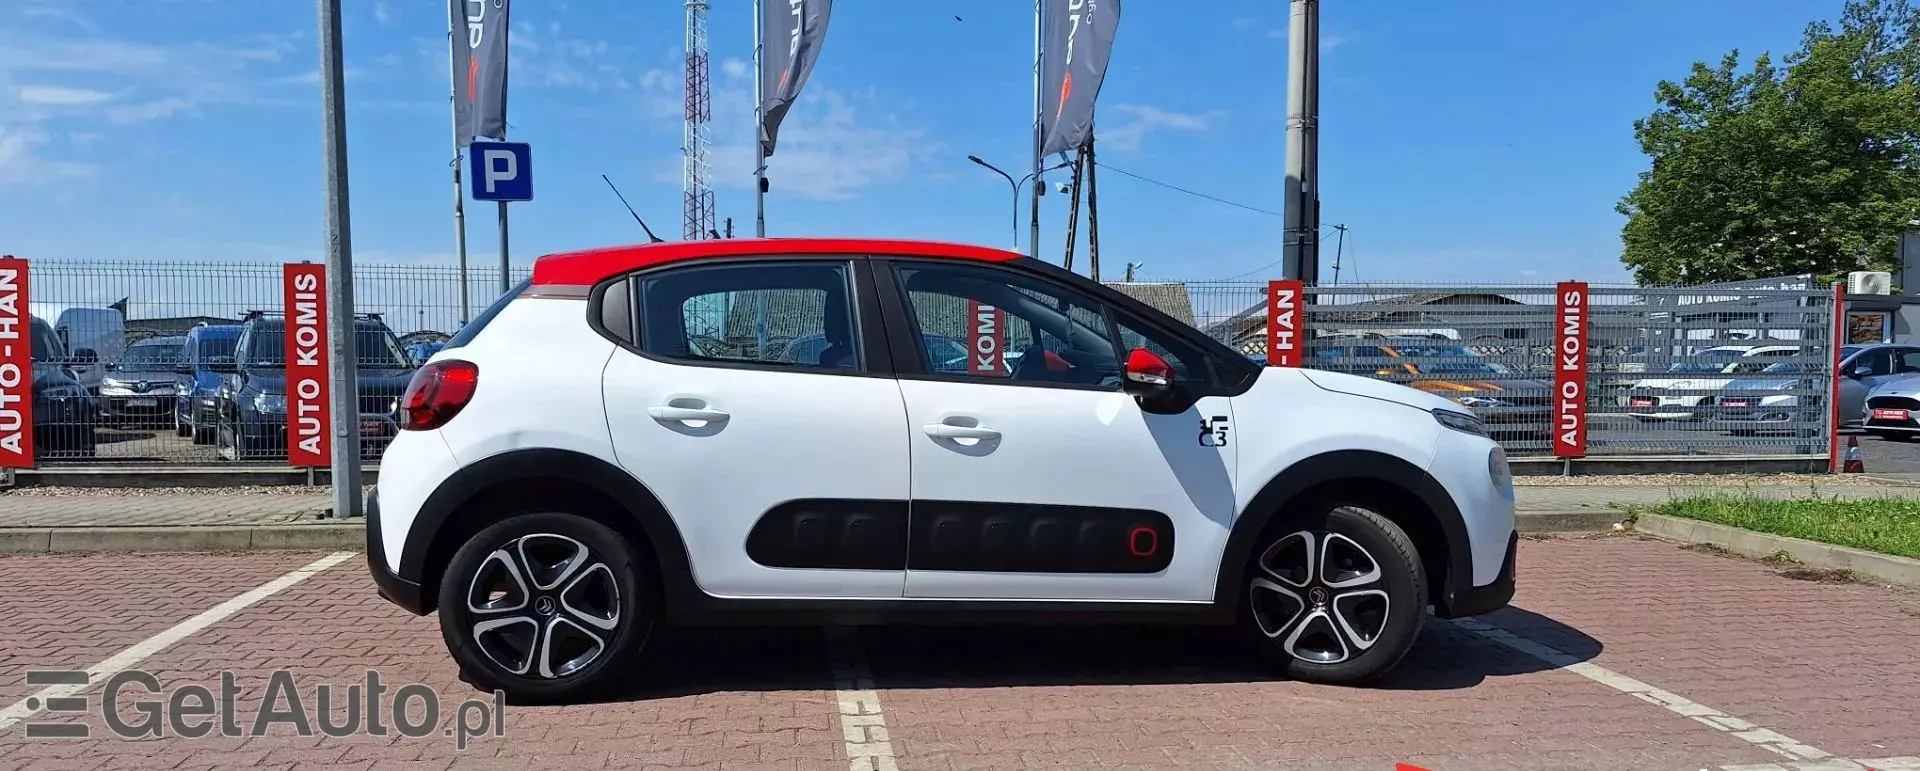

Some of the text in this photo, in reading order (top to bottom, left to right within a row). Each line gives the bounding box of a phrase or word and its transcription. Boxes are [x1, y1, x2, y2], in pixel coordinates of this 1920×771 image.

[484, 149, 517, 193] P
[294, 273, 321, 455] AUTO KOMIS
[977, 305, 996, 371] KOMI
[1276, 290, 1295, 365] -HAN
[1561, 291, 1581, 447] AUTO KOMIS
